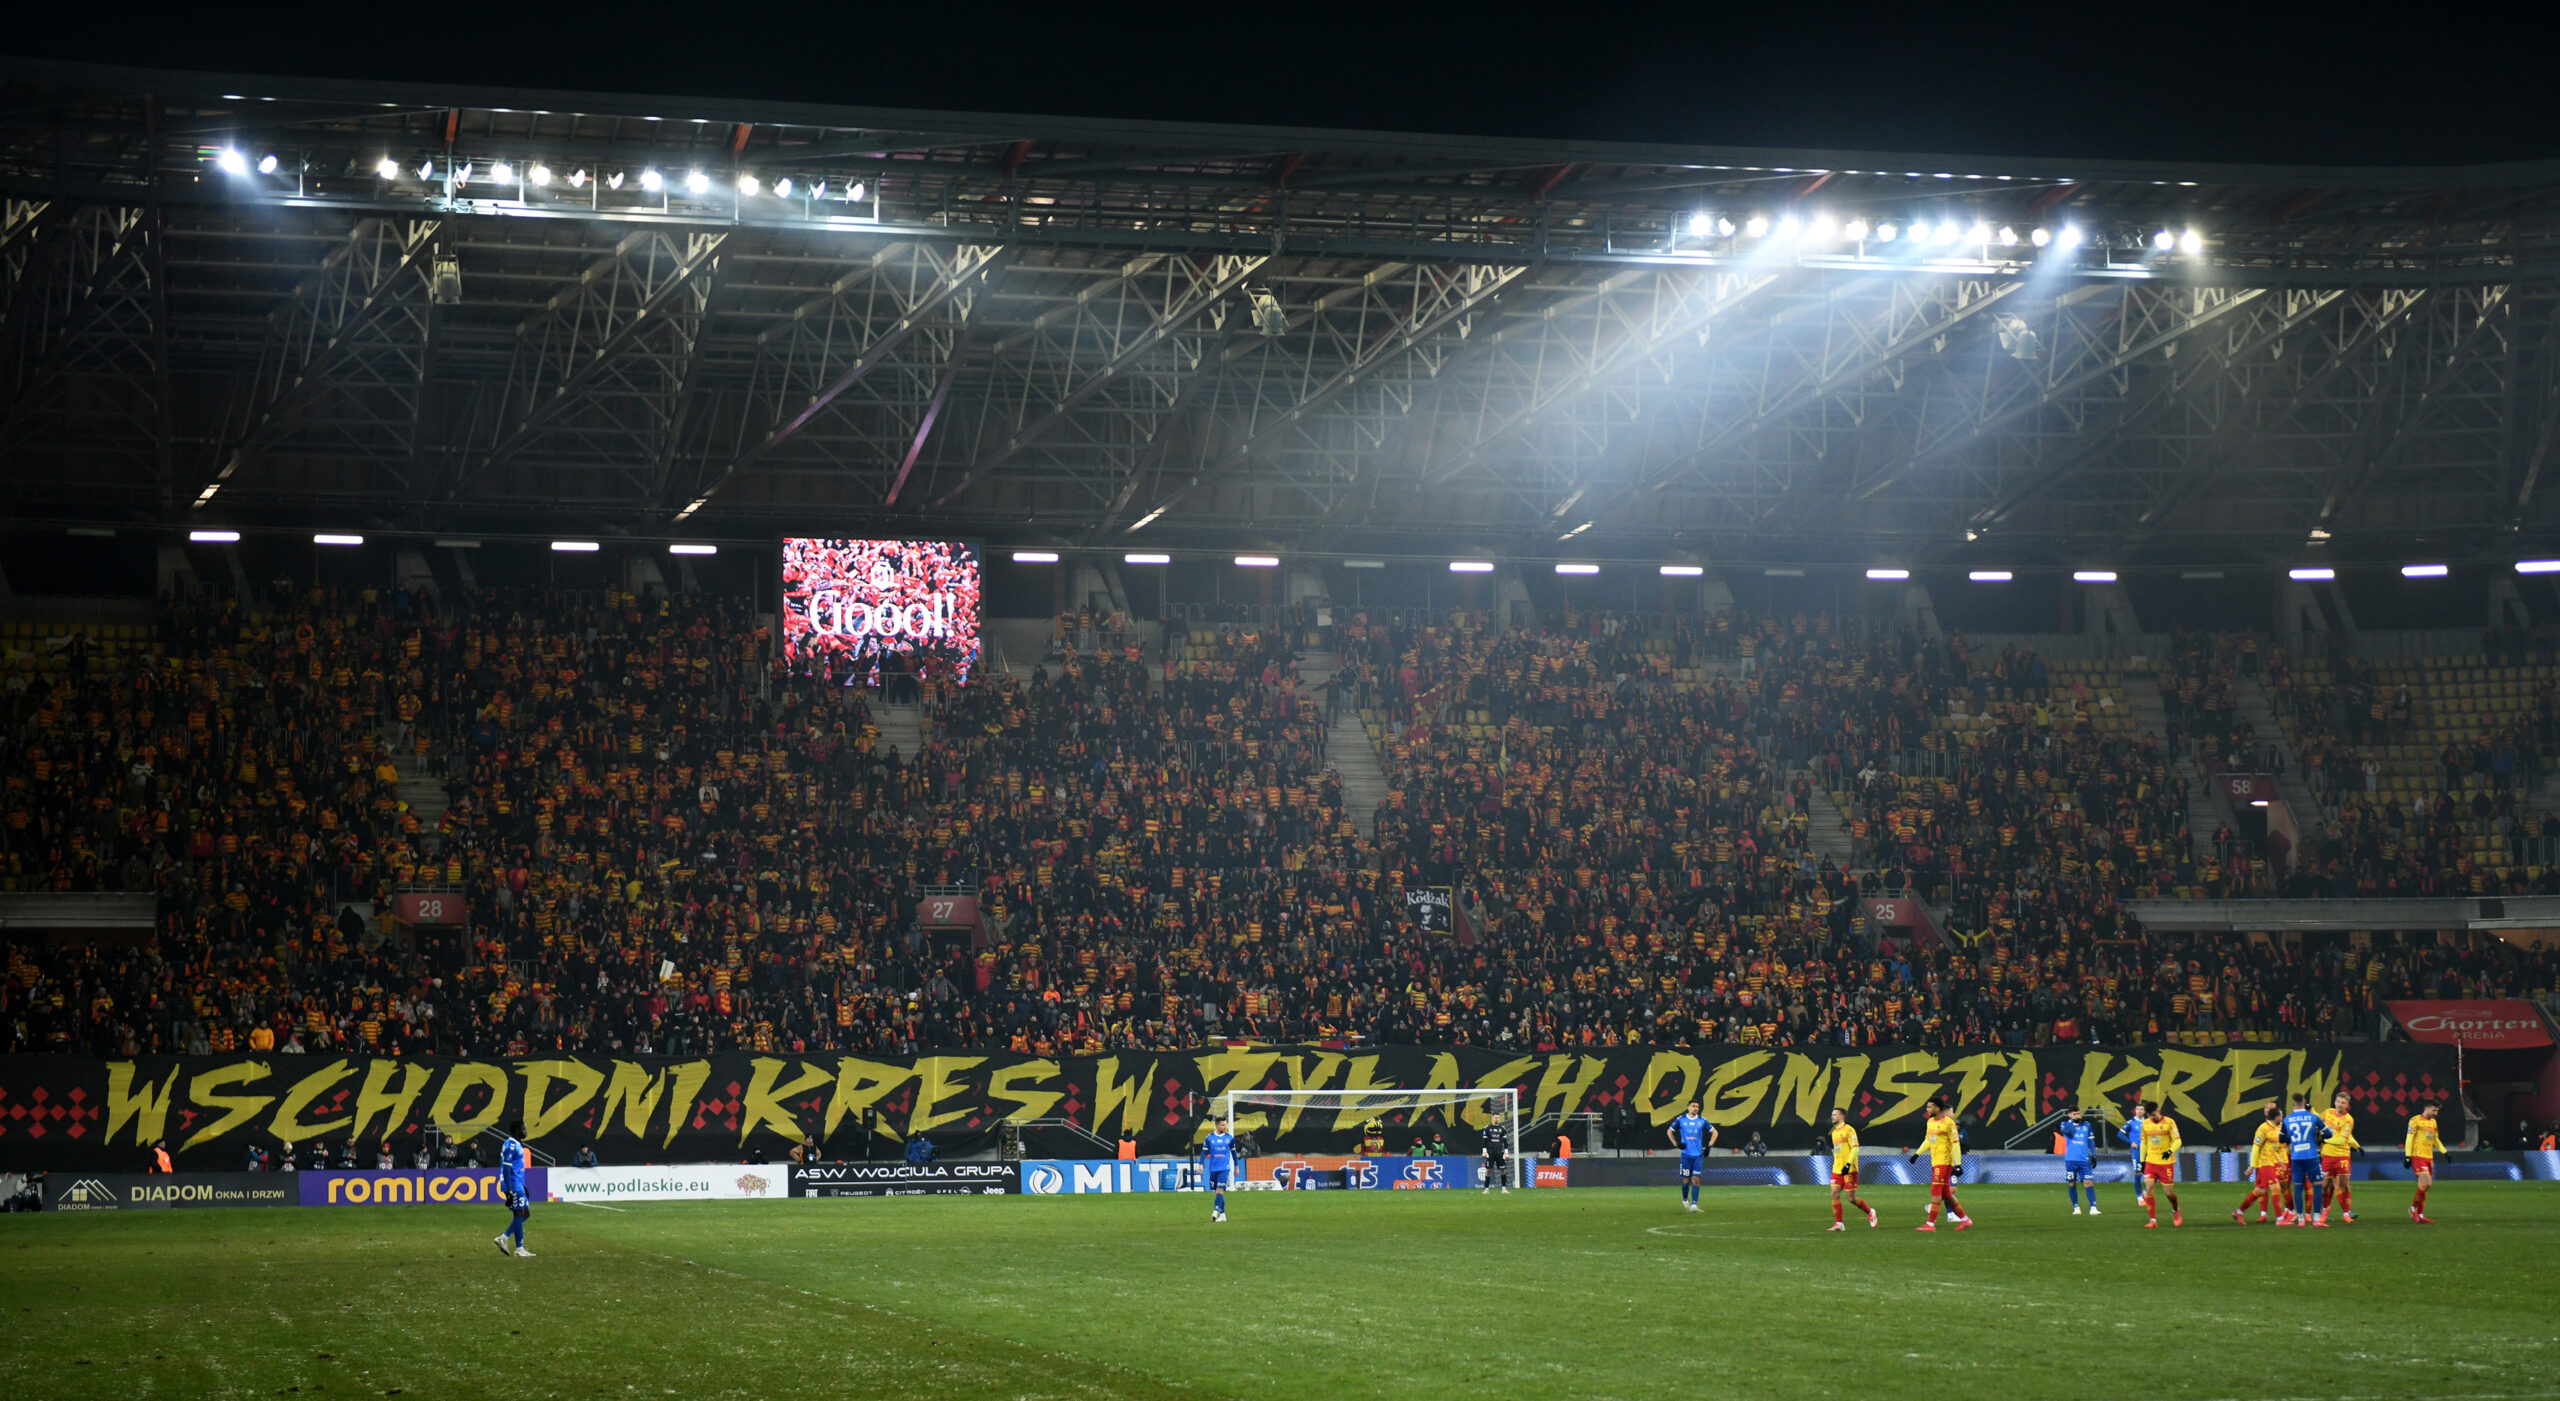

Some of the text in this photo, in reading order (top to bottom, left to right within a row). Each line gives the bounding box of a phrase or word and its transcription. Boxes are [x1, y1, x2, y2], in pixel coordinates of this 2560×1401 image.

[2232, 780, 2251, 794] 58
[419, 900, 442, 917] 28
[932, 901, 954, 918] 27
[1876, 904, 1895, 919] 25
[2407, 1015, 2538, 1031] Chorten
[2453, 1031, 2505, 1039] ARENA
[105, 1056, 711, 1151] WSCHODNI
[739, 1057, 1064, 1148] KRES
[1092, 1055, 1158, 1138] W
[1632, 1050, 2037, 1134] OGNISTA
[2076, 1048, 2342, 1132] KREW
[2289, 1122, 2312, 1142] 37
[795, 1165, 1015, 1179] ASW WOJCIULA GRUPA
[1537, 1171, 1565, 1180] STIHL
[131, 1185, 213, 1202] DIADOM
[215, 1190, 244, 1199] OKNA
[252, 1189, 284, 1199] DRZWI
[565, 1178, 709, 1195] www.podlaskie.eu
[805, 1189, 818, 1198] FIAT
[983, 1186, 1005, 1195] Jeep
[58, 1203, 90, 1211] DIADOM
